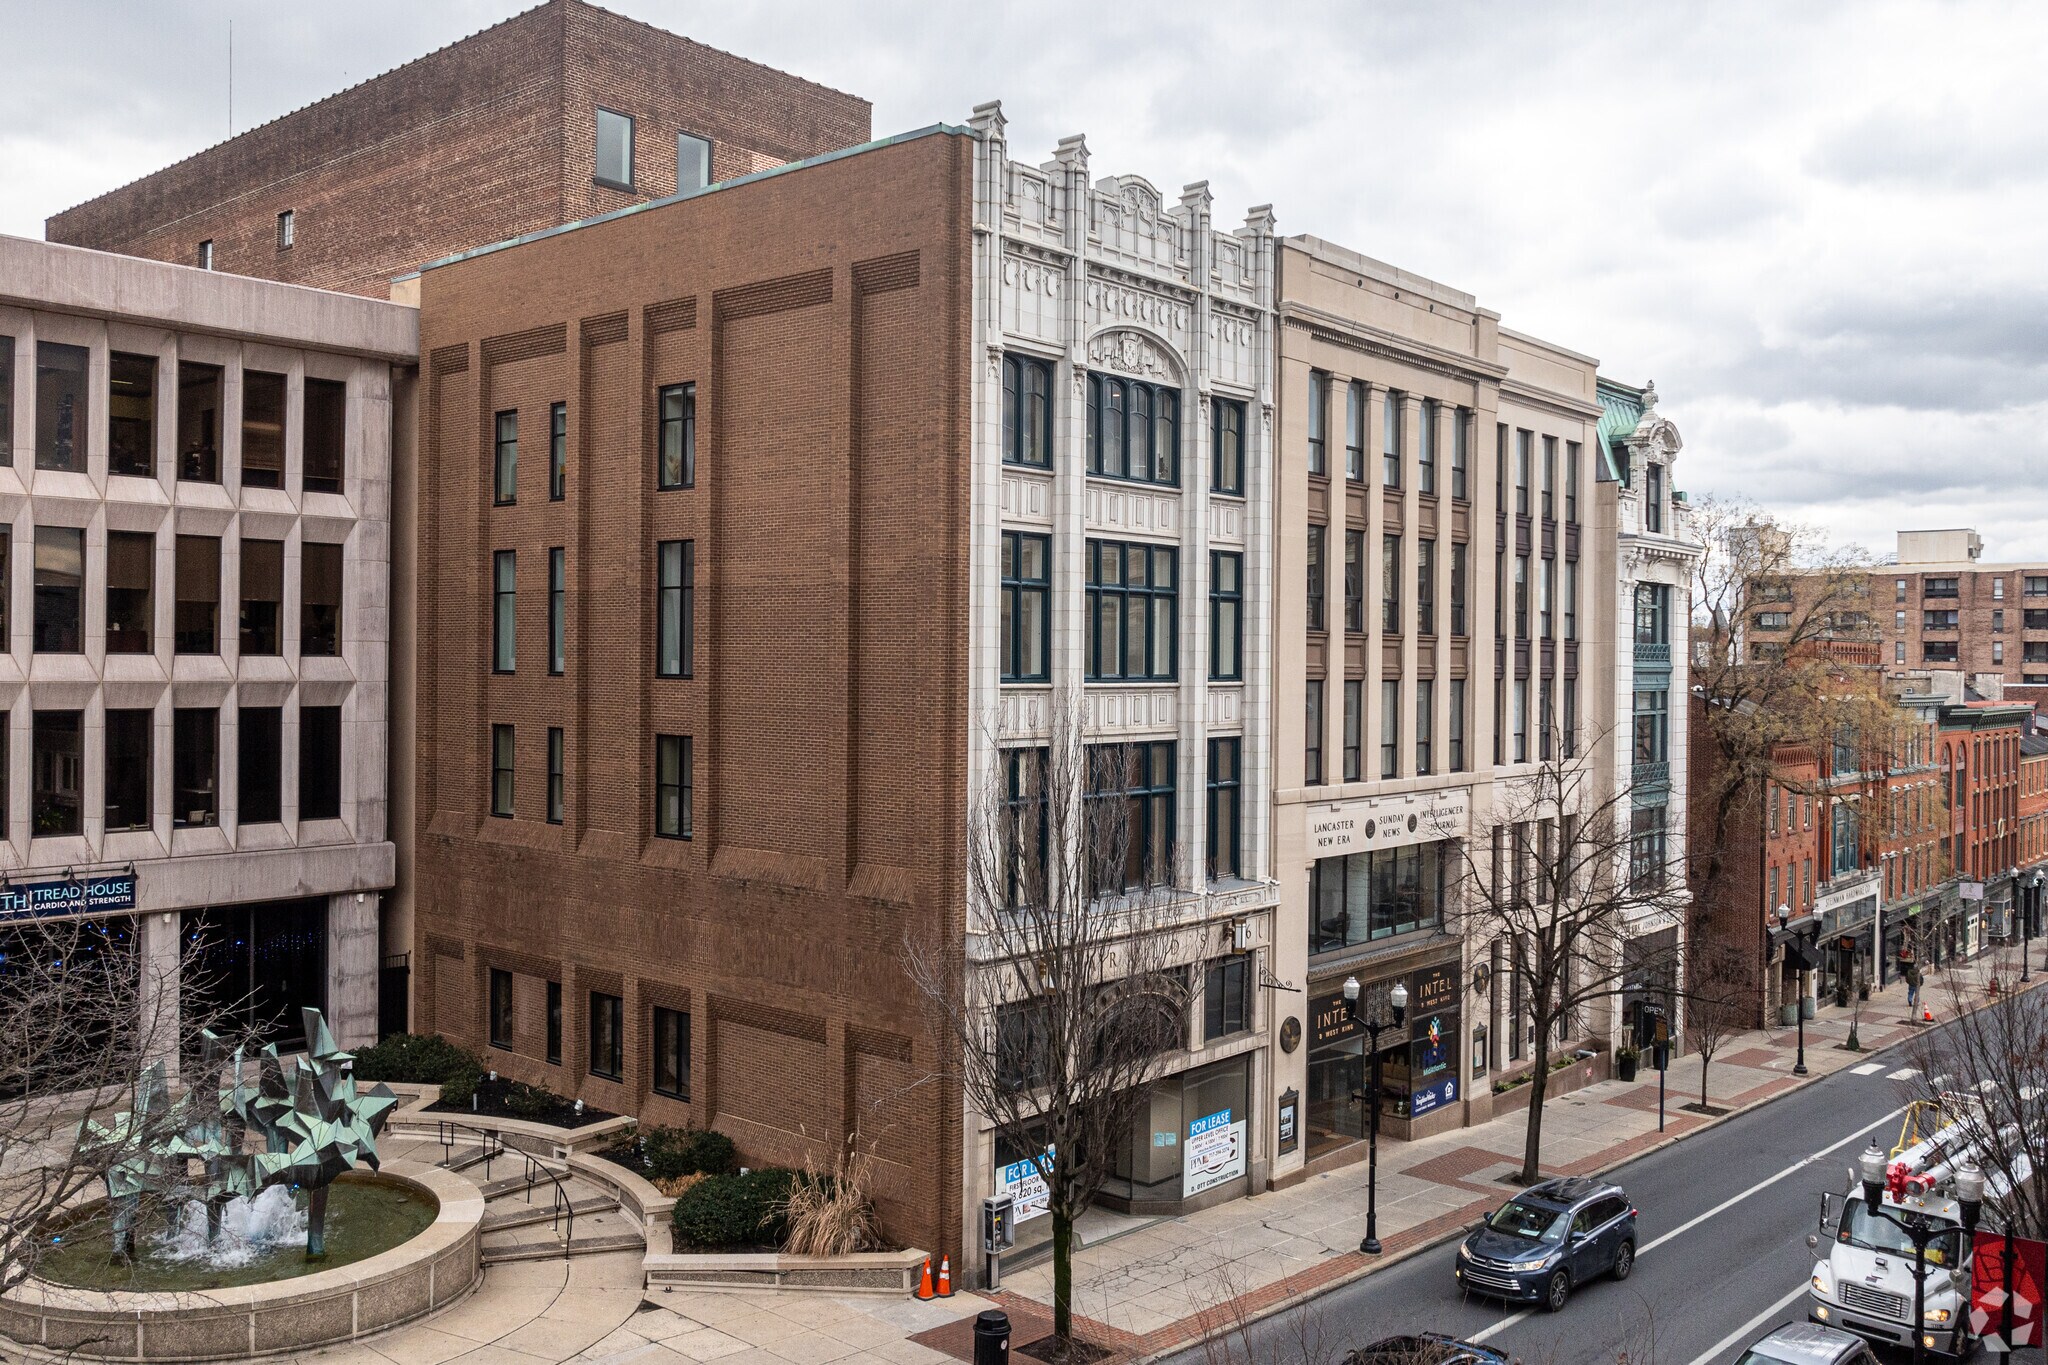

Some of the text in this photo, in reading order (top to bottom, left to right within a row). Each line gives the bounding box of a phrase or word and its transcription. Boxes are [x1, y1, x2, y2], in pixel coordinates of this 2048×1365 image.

[1379, 814, 1404, 825] SUNDAY
[1420, 806, 1464, 819] INTELLIGENCER
[1314, 820, 1354, 833] LANCASTER
[1429, 819, 1457, 831] JOURNAL
[1383, 828, 1401, 838] NEWS
[1318, 835, 1351, 847] NEW ERA
[34, 882, 131, 901] TREAD HOUSE
[34, 900, 67, 910] CARDIO
[89, 895, 131, 905] STRENGTH
[1420, 977, 1452, 998] INTEL
[1427, 998, 1438, 1007] WEST
[1440, 994, 1451, 1002] KING
[1644, 1005, 1665, 1015] OPEN
[1317, 1007, 1348, 1029] INTE
[1325, 1028, 1339, 1038] WEST
[1342, 1023, 1354, 1033] KING
[1191, 1111, 1229, 1135] FOR LEASE
[1191, 1126, 1229, 1144] UPPER LEVEL OFFICE
[1008, 1163, 1028, 1181] FOR
[1196, 1181, 1206, 1190] OTT
[1206, 1169, 1239, 1186] CONSTRUCTION
[1010, 1175, 1040, 1191] FIRST FLOOR
